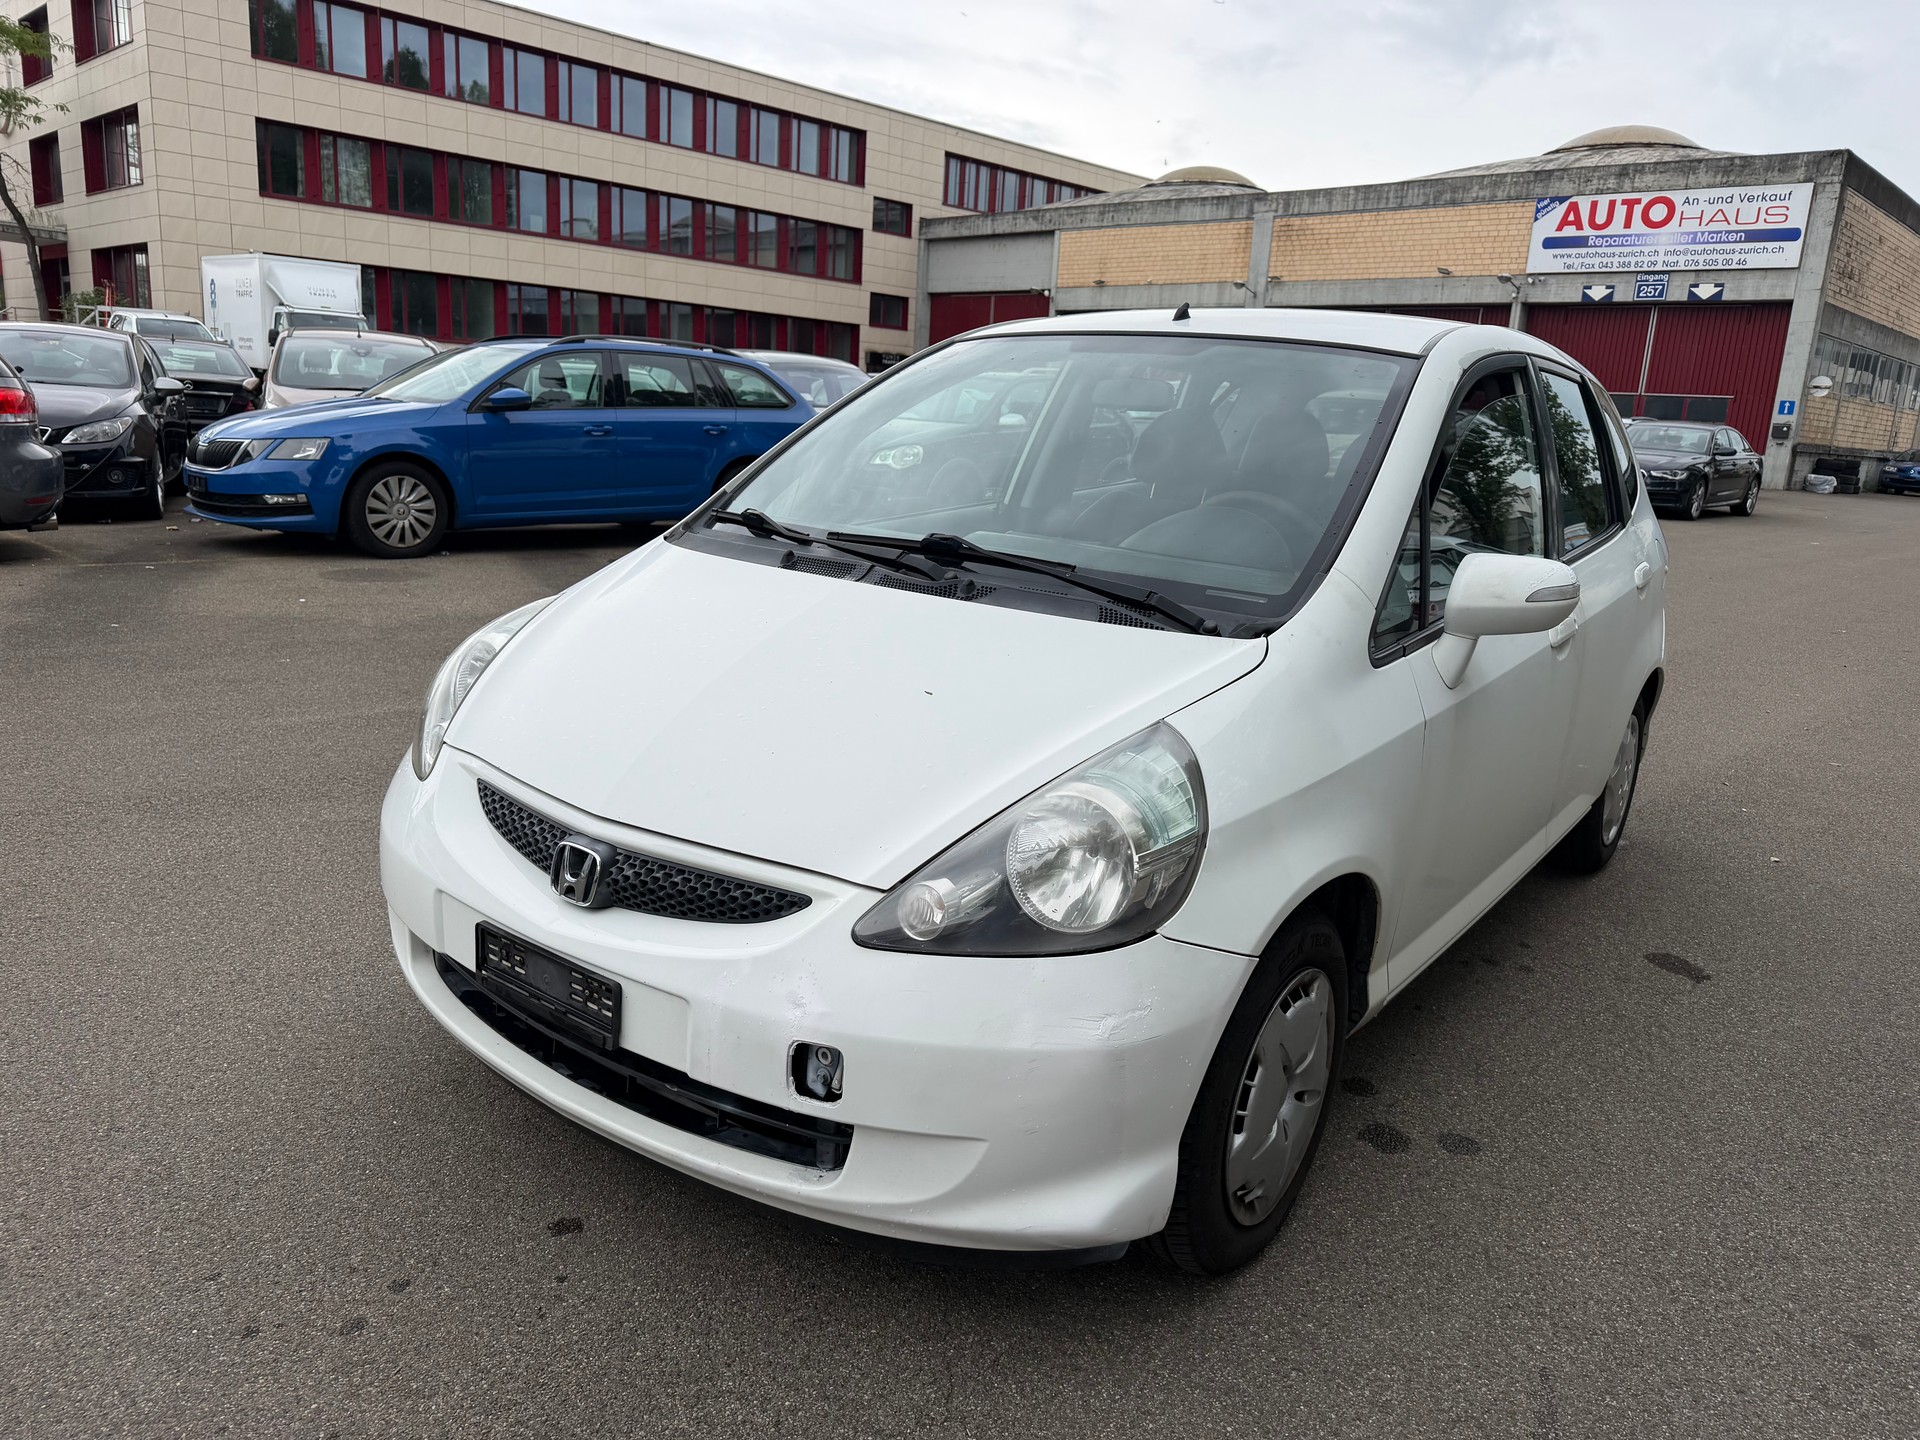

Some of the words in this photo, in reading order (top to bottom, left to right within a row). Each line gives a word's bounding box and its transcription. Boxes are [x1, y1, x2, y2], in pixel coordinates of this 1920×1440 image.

[1537, 197, 1551, 209] Hier
[1682, 196, 1699, 206] An
[1703, 193, 1734, 205] -und
[1738, 190, 1793, 203] Verkauf
[1536, 200, 1560, 219] günstig
[1555, 195, 1676, 232] AUTO
[1678, 205, 1790, 228] HAUS
[1588, 235, 1663, 247] Reparature
[1696, 231, 1745, 243] Marken
[1552, 249, 1660, 259] www.autohaus-zurich.ch
[1664, 245, 1785, 257] info@autohaus-zurich.ch
[1563, 261, 1595, 270] Tel./Fax
[1598, 260, 1614, 269] 043
[1616, 260, 1632, 269] 388
[1634, 260, 1645, 268] 82
[1646, 260, 1658, 268] 09
[1662, 259, 1681, 268] Nat.
[1684, 259, 1700, 267] 076
[1702, 259, 1719, 267] 505
[1721, 258, 1734, 266] 00
[1735, 258, 1748, 266] 46
[1637, 273, 1669, 281] Eingang
[1639, 286, 1663, 297] 257
